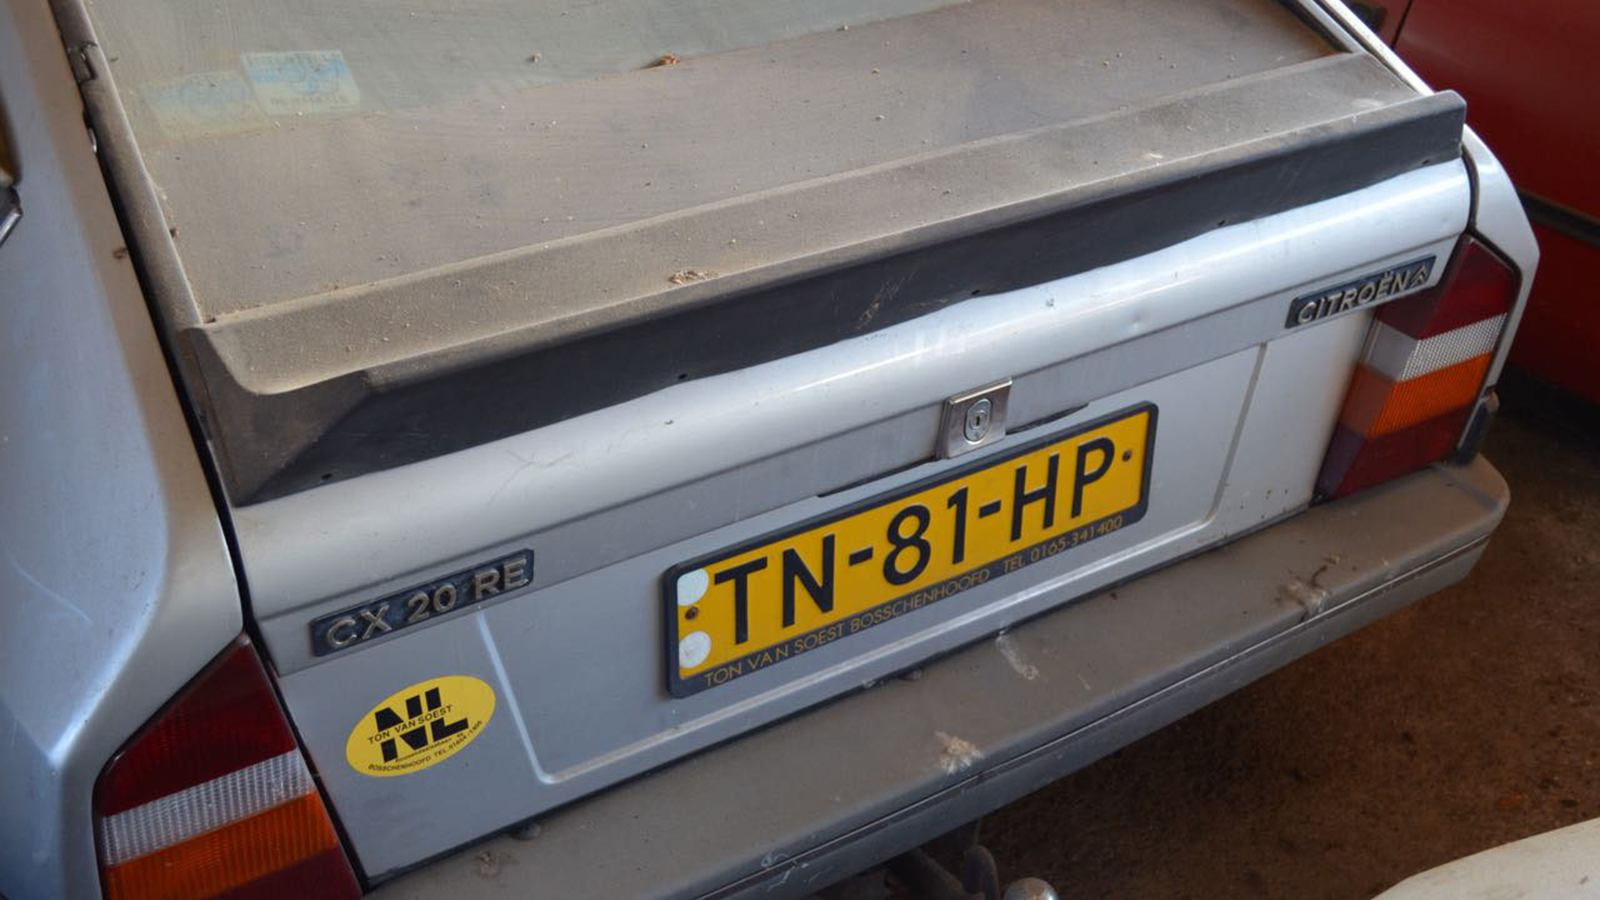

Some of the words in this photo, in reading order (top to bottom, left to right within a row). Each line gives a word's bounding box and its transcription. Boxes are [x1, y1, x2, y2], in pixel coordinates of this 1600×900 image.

[1298, 270, 1410, 324] CITROËN
[714, 437, 1116, 645] TN-81-HP
[326, 602, 392, 648] CX
[407, 583, 457, 622] 20
[474, 558, 527, 600] RE
[704, 662, 743, 687] TON
[747, 644, 789, 670] VAN
[794, 623, 845, 655] SOEST
[848, 568, 991, 633] BOSSCHENHOOFD
[1003, 554, 1027, 574] TEL
[367, 730, 391, 745] TON
[394, 720, 417, 734] VAN
[417, 704, 454, 725] SOEST
[374, 686, 469, 763] NL
